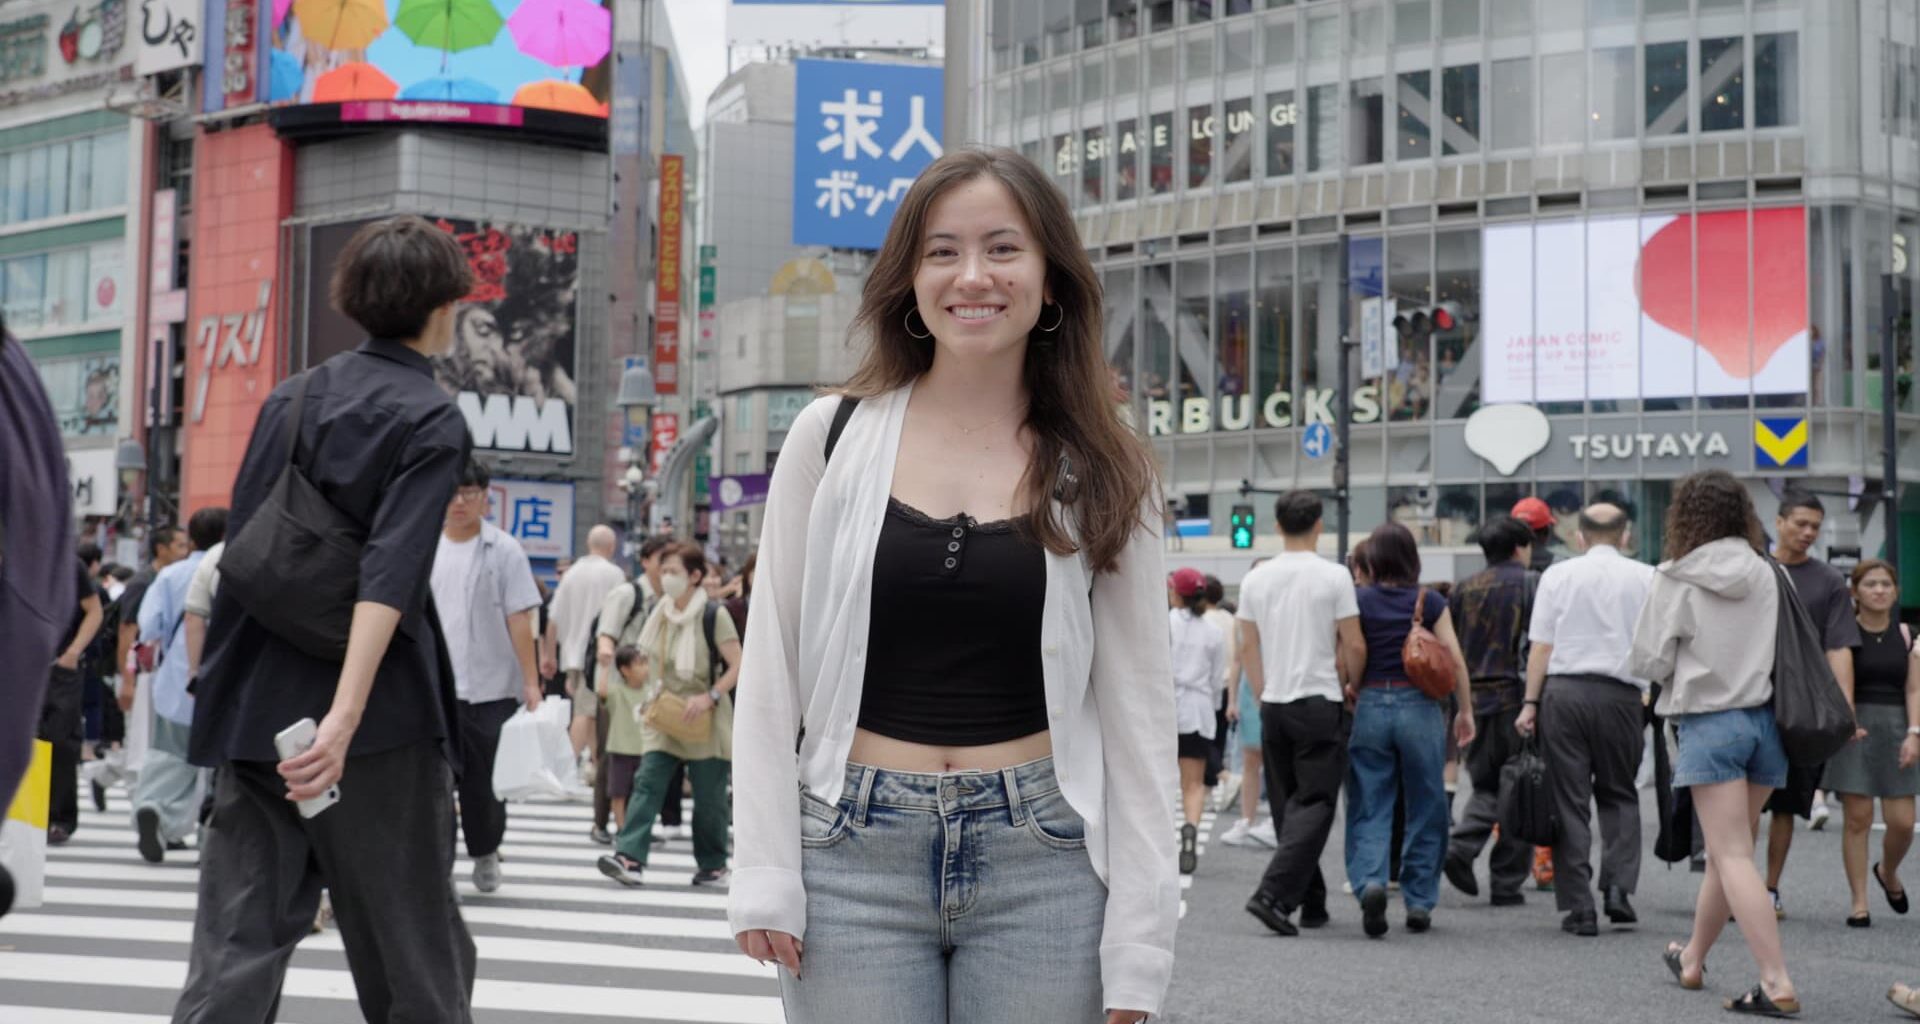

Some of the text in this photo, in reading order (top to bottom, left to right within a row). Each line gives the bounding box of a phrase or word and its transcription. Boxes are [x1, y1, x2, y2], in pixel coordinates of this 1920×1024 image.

[816, 89, 944, 162] 求人
[1191, 104, 1297, 139] LOUNGE
[192, 278, 273, 421] クスリ
[1506, 332, 1622, 348] JAPAN COMIC
[1568, 431, 1729, 459] TSUTAYA
